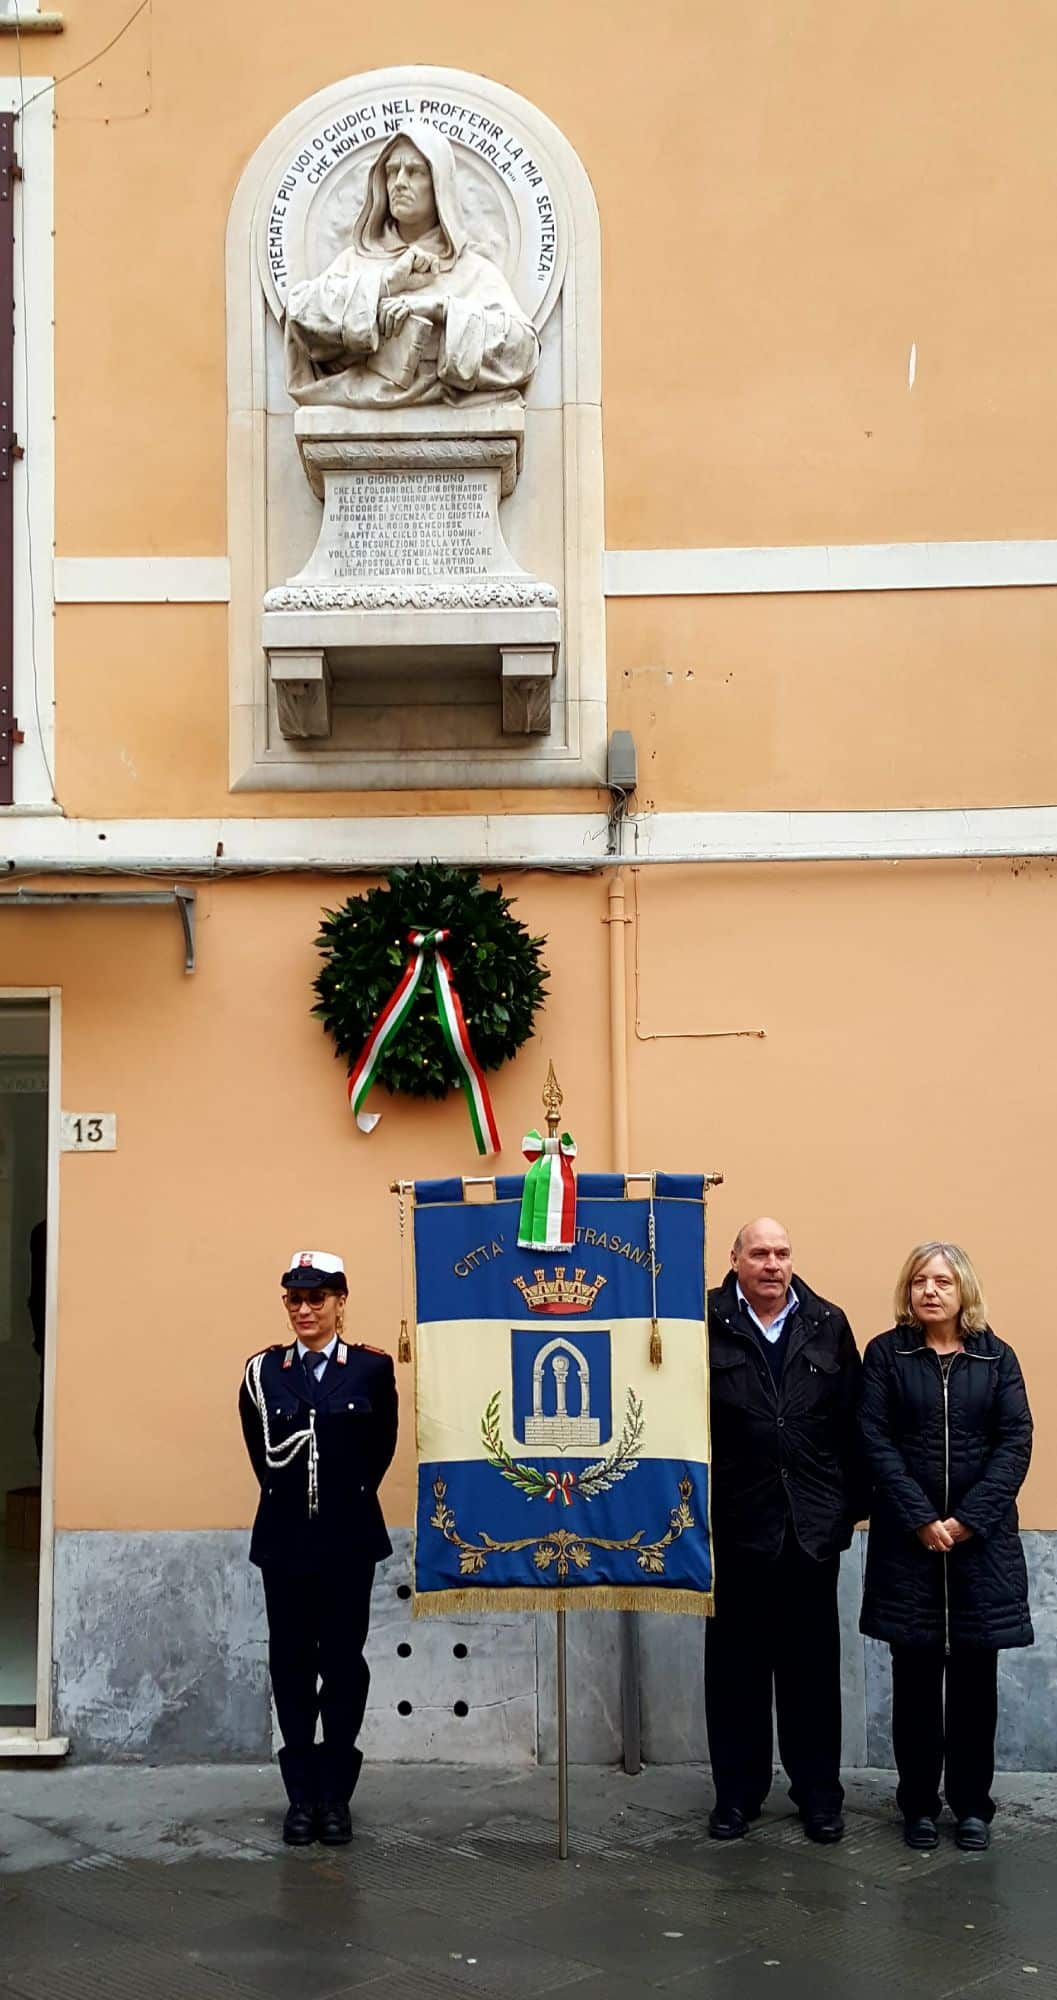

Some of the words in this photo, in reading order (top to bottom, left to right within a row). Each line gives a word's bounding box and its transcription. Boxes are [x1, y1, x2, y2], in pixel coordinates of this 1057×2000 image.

[278, 173, 297, 205] PIU
[294, 148, 316, 179] VOI
[312, 137, 325, 152] O
[324, 106, 378, 143] GIUDICI
[382, 99, 415, 118] NEL
[420, 100, 504, 140] PROFFERIR
[504, 137, 524, 161] LA
[521, 159, 545, 189] MIA
[307, 155, 333, 186] CHE
[332, 134, 360, 158] NON
[357, 126, 377, 143] IO
[356, 477, 364, 485] DI
[368, 475, 423, 485] GIORDANO
[427, 474, 465, 483] BRUNO
[334, 487, 350, 495] CHE
[352, 487, 362, 495] LE
[401, 486, 414, 494] DEL
[442, 484, 488, 493] DIVINATORE
[358, 495, 376, 504] EVO
[429, 494, 483, 503] AVVENTANDO
[339, 504, 383, 513] PRECORSE
[391, 504, 412, 513] VERI
[378, 513, 387, 522] DI
[389, 513, 426, 522] SCIENZA
[436, 512, 445, 521] DI
[447, 511, 490, 521] GIUSTIZIA
[357, 522, 364, 531] E
[365, 522, 384, 531] DAL
[412, 521, 463, 529] BENEDISSE
[378, 530, 390, 539] AL
[392, 530, 418, 539] CIELO
[420, 530, 445, 538] DAGLI
[348, 540, 361, 549] LE
[420, 538, 448, 548] DELLA
[450, 538, 472, 547] VITA
[328, 549, 367, 559] VOLLERO
[369, 549, 386, 558] CON
[387, 549, 400, 558] LE
[452, 547, 493, 556] EVOCARE
[421, 558, 430, 566] IL
[416, 567, 445, 576] DELLA
[447, 566, 488, 576] VERSILIA
[73, 1119, 104, 1143] 13
